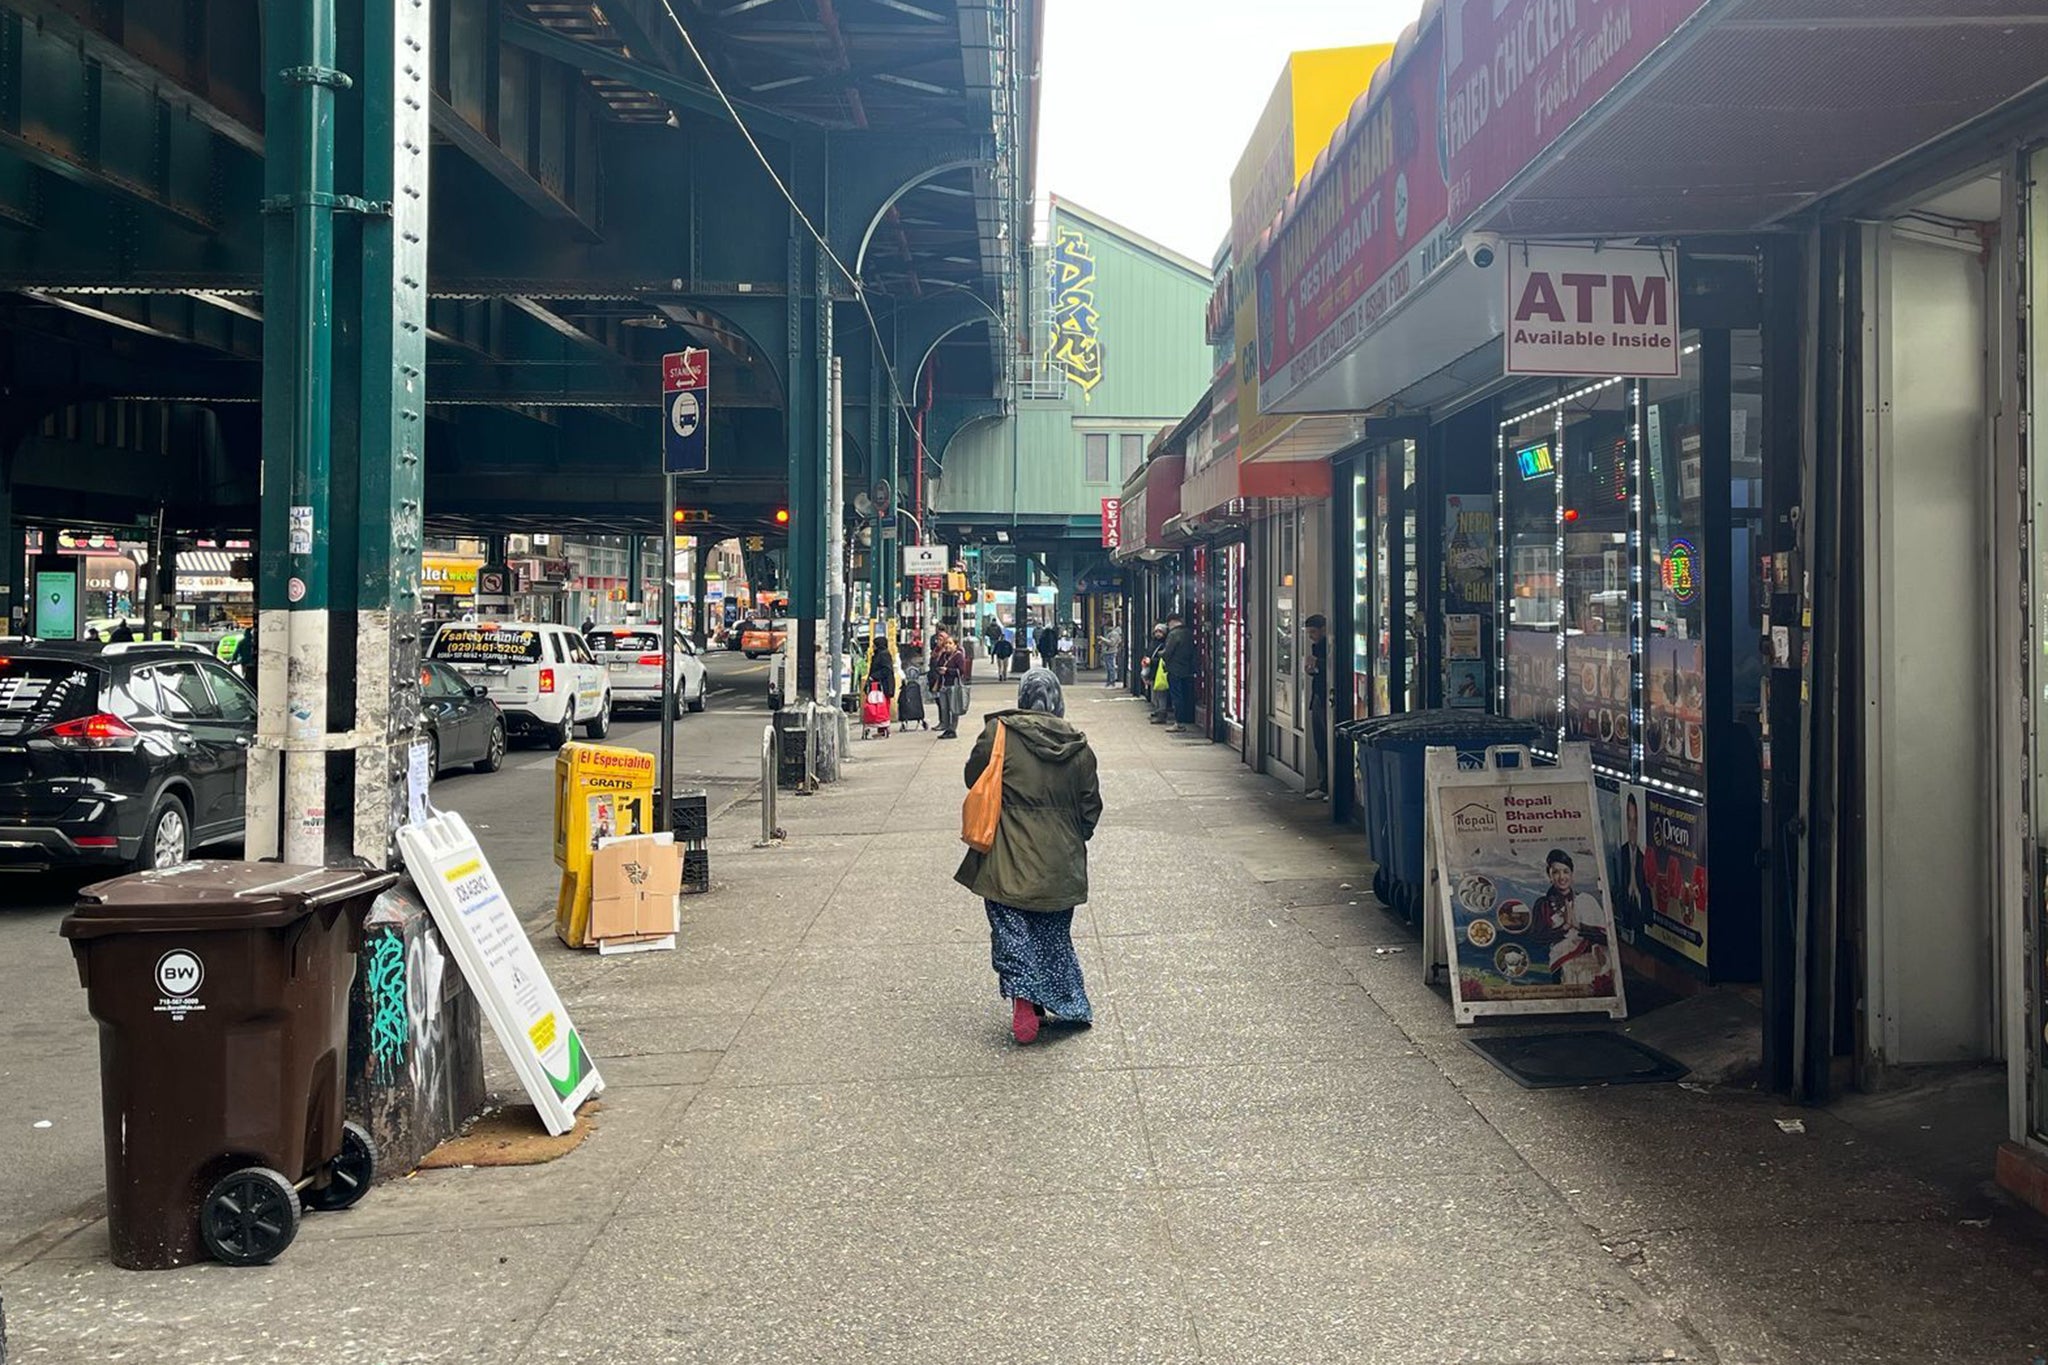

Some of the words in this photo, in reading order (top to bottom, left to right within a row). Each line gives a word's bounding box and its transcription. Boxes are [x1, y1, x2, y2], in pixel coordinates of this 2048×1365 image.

[1534, 48, 1569, 136] Food
[1569, 5, 1632, 98] Junction
[1449, 64, 1490, 157] FRIED
[1350, 96, 1394, 204] GHAR
[1301, 190, 1381, 309] RESTAURANT
[1514, 272, 1668, 325] ATM
[1514, 329, 1606, 346] Available
[1612, 332, 1672, 348] Inside
[670, 365, 701, 378] STANDING
[1106, 500, 1119, 547] CEJAS
[447, 643, 526, 655] (929)461-5203
[580, 751, 591, 764] El
[594, 752, 651, 769] Especialito
[589, 778, 633, 790] GRATIS
[1504, 796, 1552, 808] Nepali
[1456, 813, 1494, 828] Nepali
[1506, 809, 1582, 821] Bhanchha
[1507, 824, 1544, 834] Ghar
[165, 967, 194, 980] BW
